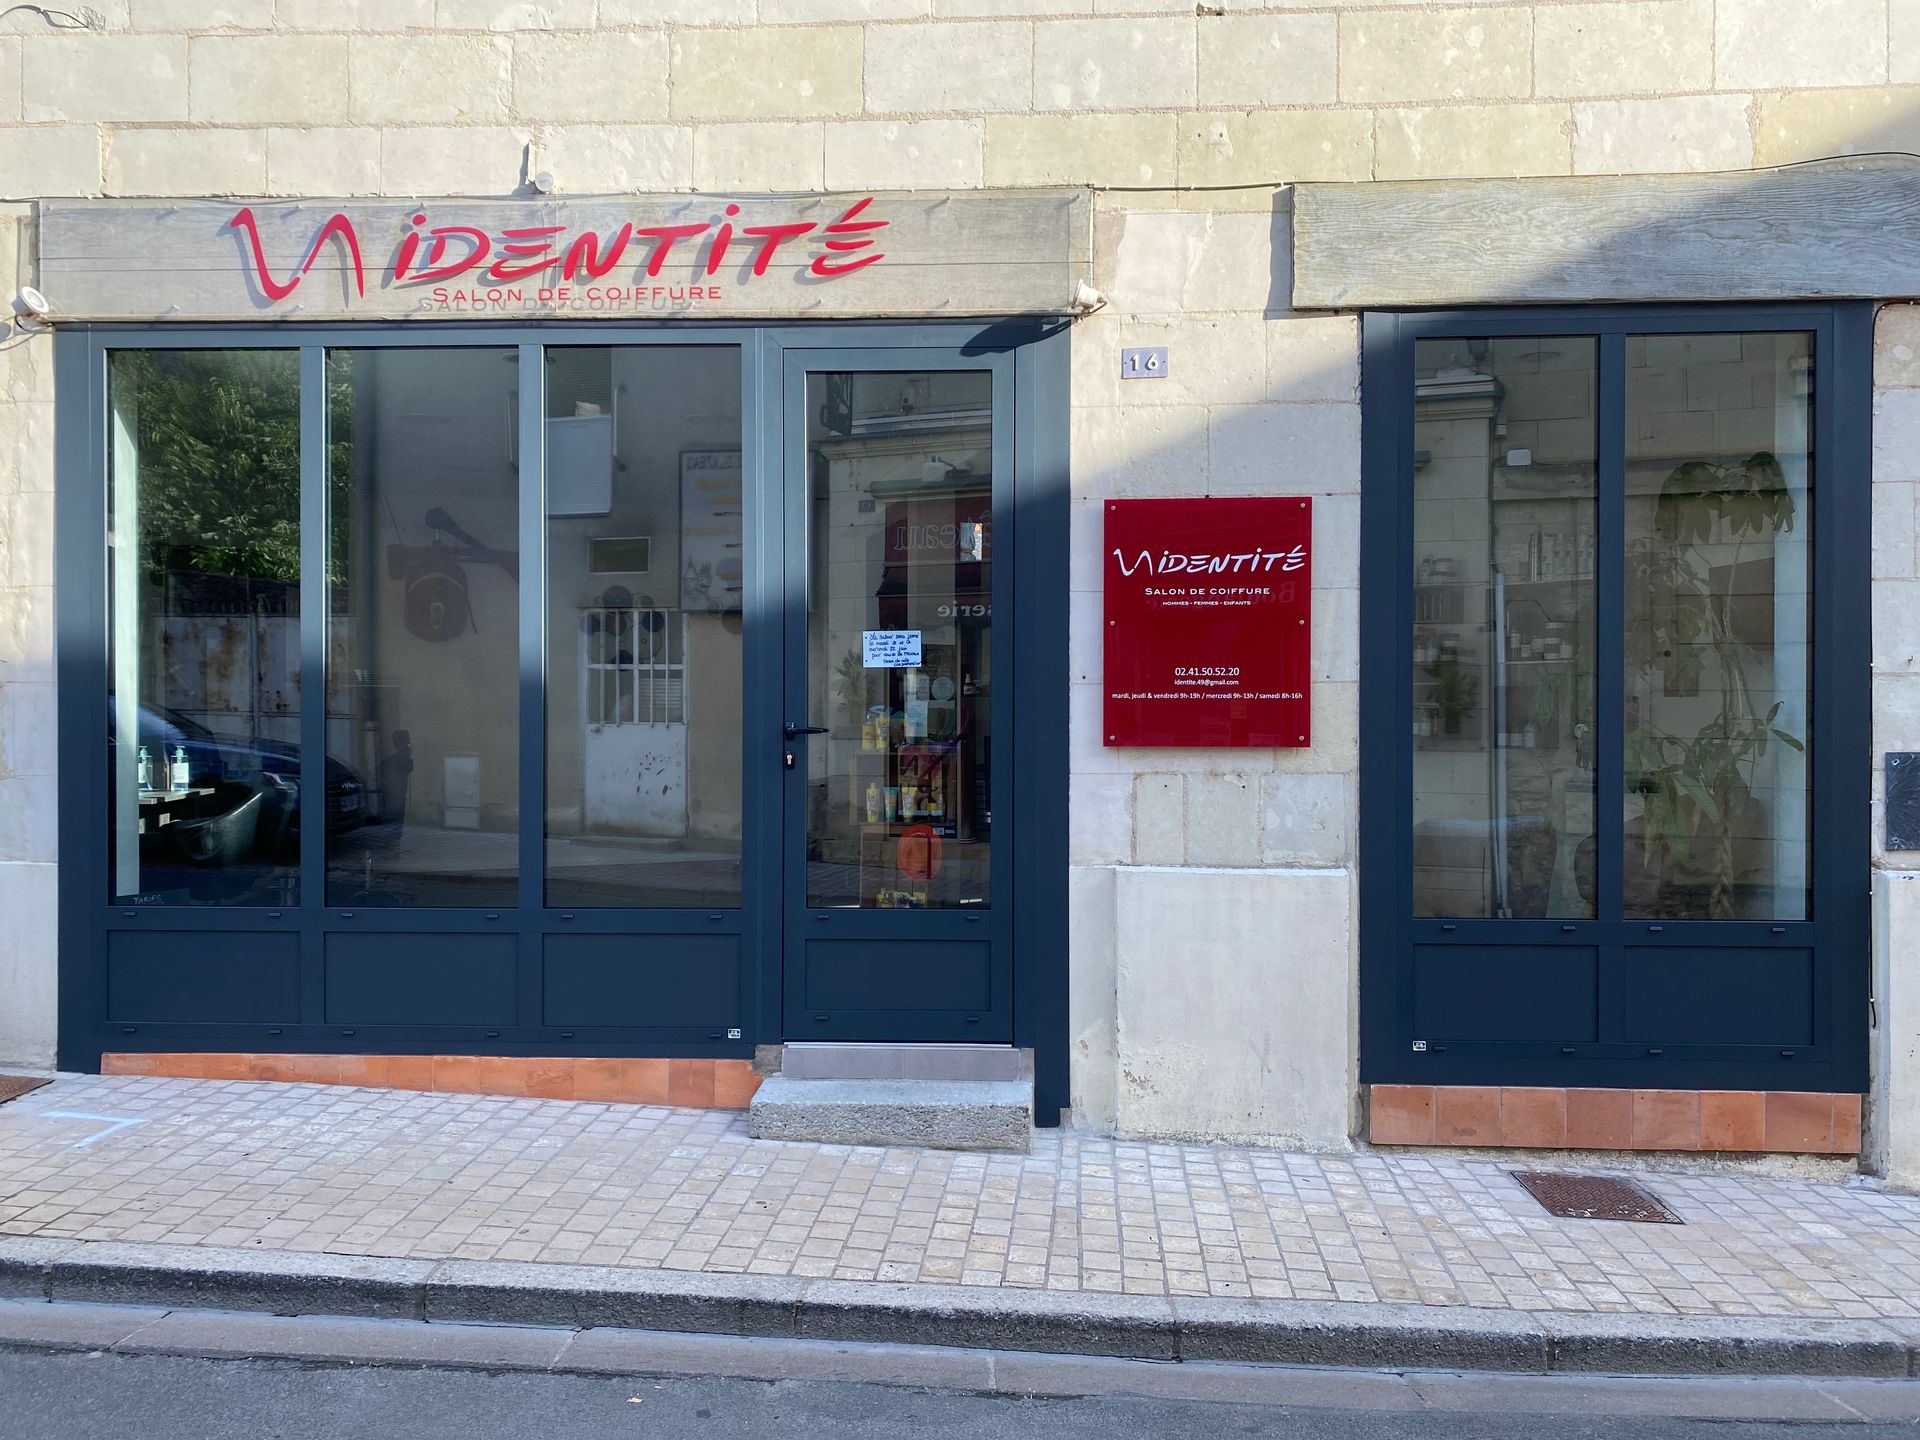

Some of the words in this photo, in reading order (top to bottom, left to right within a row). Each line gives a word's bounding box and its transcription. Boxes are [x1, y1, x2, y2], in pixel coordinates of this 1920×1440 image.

[538, 287, 572, 302] DE
[586, 286, 722, 301] COIFFURE
[1129, 353, 1159, 372] 16
[1189, 588, 1206, 596] DE
[1209, 587, 1271, 595] COIFFURE
[1174, 667, 1240, 676] 02.41.50.52.20
[1174, 679, 1239, 687] identite.49@gmail.com
[1112, 692, 1131, 700] mardi,
[1131, 692, 1147, 700] jeudi
